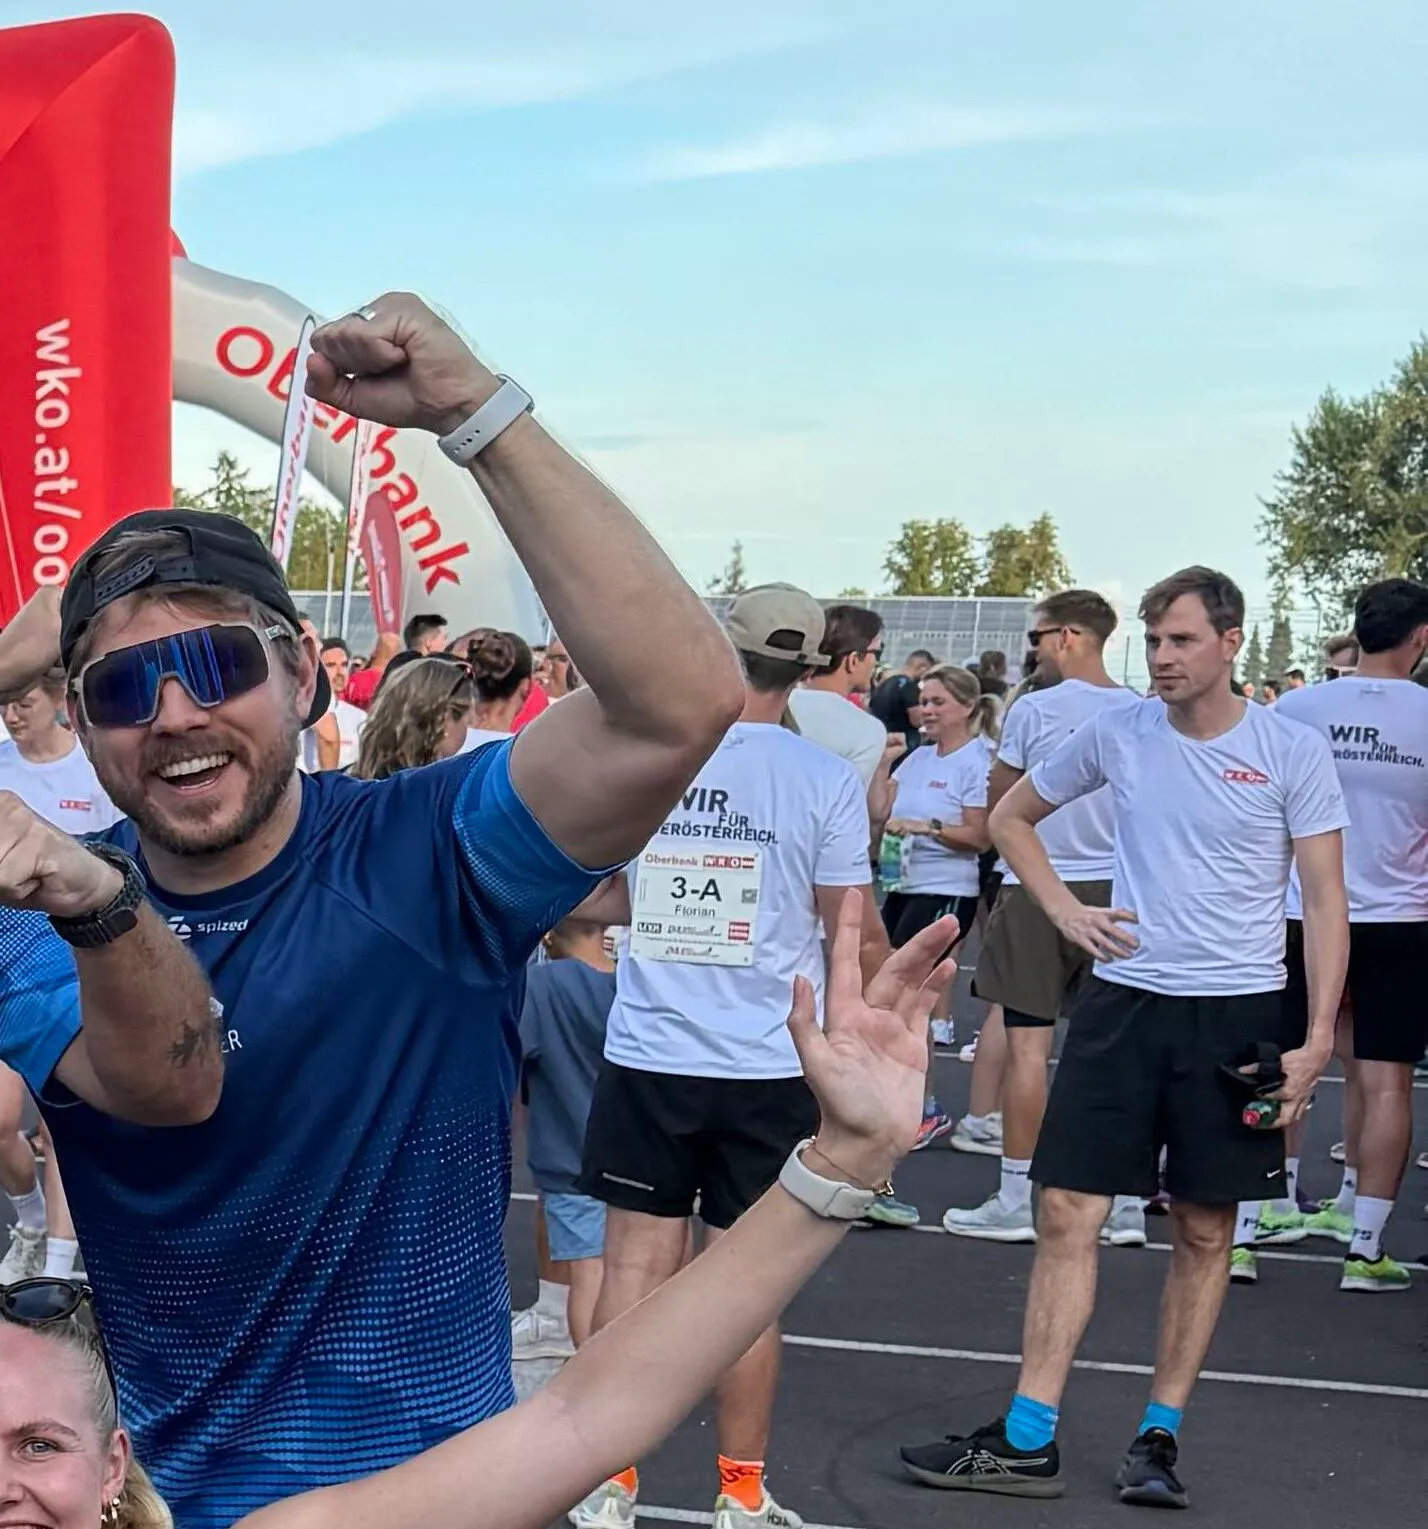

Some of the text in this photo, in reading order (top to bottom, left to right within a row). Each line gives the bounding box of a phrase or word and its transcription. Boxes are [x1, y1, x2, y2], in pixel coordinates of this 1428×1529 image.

[1329, 724, 1380, 744] WIR
[718, 811, 750, 828] FÜR
[670, 876, 723, 903] 3-A
[675, 904, 716, 918] Florian
[196, 918, 249, 935] spized
